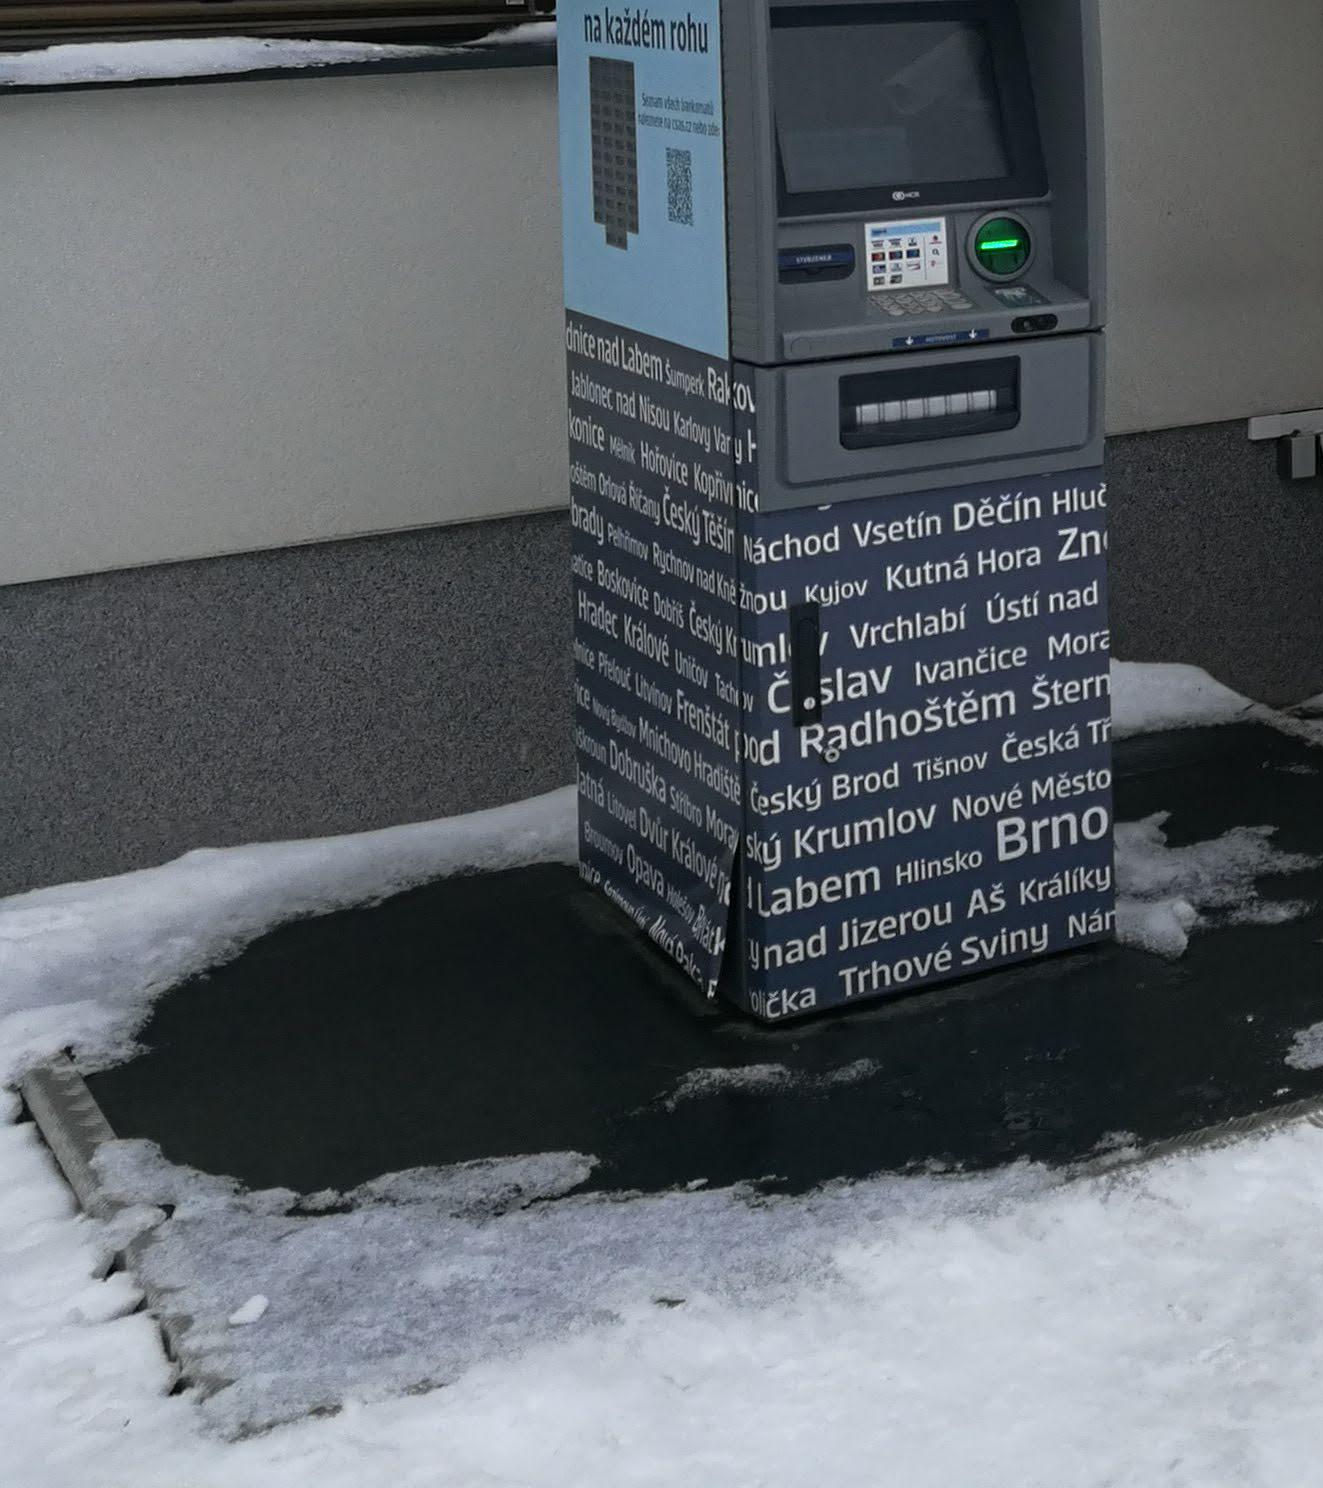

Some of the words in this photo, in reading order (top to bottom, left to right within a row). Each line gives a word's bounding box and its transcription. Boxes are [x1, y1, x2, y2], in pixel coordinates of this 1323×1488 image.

[584, 13, 602, 44] na
[605, 6, 667, 51] každém
[670, 13, 709, 54] rohu
[566, 320, 595, 359] dnice
[598, 335, 619, 368] nad
[621, 338, 664, 383] Labem
[665, 358, 705, 398] Šumperk
[568, 408, 605, 452] konice
[640, 440, 689, 487] Hořovice
[571, 370, 613, 410] Jablonec
[616, 390, 636, 419] nad
[638, 393, 670, 432] Nisou
[673, 410, 711, 454] Karlovy
[571, 496, 605, 546] brady
[607, 522, 649, 562] Pelhřimov
[652, 541, 695, 584] Rychnov
[696, 567, 715, 594] nad
[805, 578, 868, 610] Kyjov
[885, 552, 969, 593] Kutná
[977, 545, 1042, 576] Hora
[1058, 526, 1109, 563] Zn
[599, 472, 628, 506] Orlová
[628, 479, 661, 527] Říčany
[663, 485, 700, 547] Český
[702, 508, 736, 555] Těšín
[743, 525, 841, 566] Náchod
[852, 511, 943, 549] Vsetín
[953, 492, 1042, 532] Děčín
[578, 589, 619, 639] Hradec
[624, 613, 670, 668] Králové
[674, 648, 709, 690] Uničov
[767, 663, 893, 714] Čslav
[915, 644, 1028, 688] Ivančice
[1048, 628, 1111, 662] Mora
[597, 559, 649, 610] Boskovice
[653, 591, 685, 629] Dobříš
[688, 599, 724, 656] Český
[850, 604, 967, 650] Vrchlabí
[985, 590, 1040, 626] Ústí
[1049, 580, 1099, 613] nad
[598, 651, 633, 693] Přelouč
[635, 672, 673, 715] Litvínov
[676, 688, 731, 751] Frenštát
[800, 687, 1016, 759] Radhoštěm
[1032, 672, 1112, 711] Štern
[609, 739, 667, 804] Dobruška
[669, 785, 703, 828] Stříbro
[794, 803, 937, 859] Krumlov
[952, 787, 1024, 824] Nové
[1031, 768, 1113, 806] Město
[639, 717, 692, 774] Mnichovo
[694, 750, 741, 806] Hradiště
[749, 777, 822, 817] Český
[832, 763, 901, 802] Brod
[913, 751, 988, 783] Tišnov
[1000, 722, 1081, 764] Česká
[626, 843, 665, 898] Opava
[763, 925, 827, 971] nad
[838, 900, 952, 952] Jizerou
[966, 882, 1006, 919] Aš
[1019, 864, 1112, 906] Králíky
[639, 806, 670, 854] Dvůr
[671, 827, 718, 890] Králové
[757, 865, 881, 919] Labem
[895, 849, 983, 887] Hlinsko
[996, 805, 1110, 862] Brno
[838, 942, 951, 999] Trhové
[961, 923, 1048, 967] Sviny
